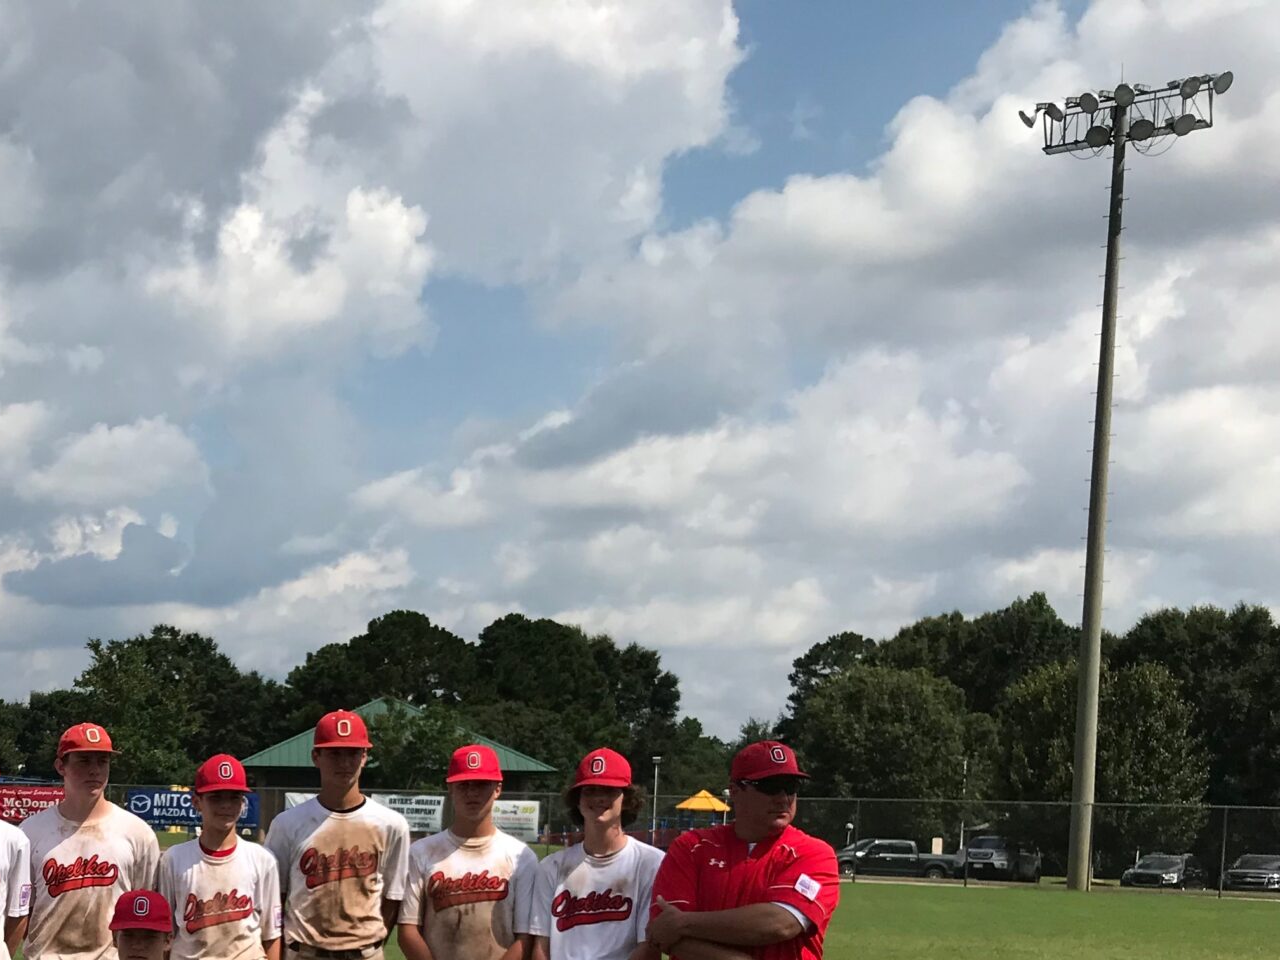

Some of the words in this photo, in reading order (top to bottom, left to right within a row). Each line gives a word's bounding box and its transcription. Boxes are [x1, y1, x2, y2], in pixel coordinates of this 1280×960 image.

[85, 728, 100, 743] O
[337, 719, 351, 736] O
[467, 752, 480, 768] O
[771, 746, 787, 763] O
[218, 762, 234, 780] O
[590, 756, 605, 775] O
[153, 808, 187, 816] MAZDA
[43, 854, 118, 888] Opelika
[428, 870, 509, 902] Opelika
[134, 896, 149, 915] O
[551, 888, 632, 921] Opelika
